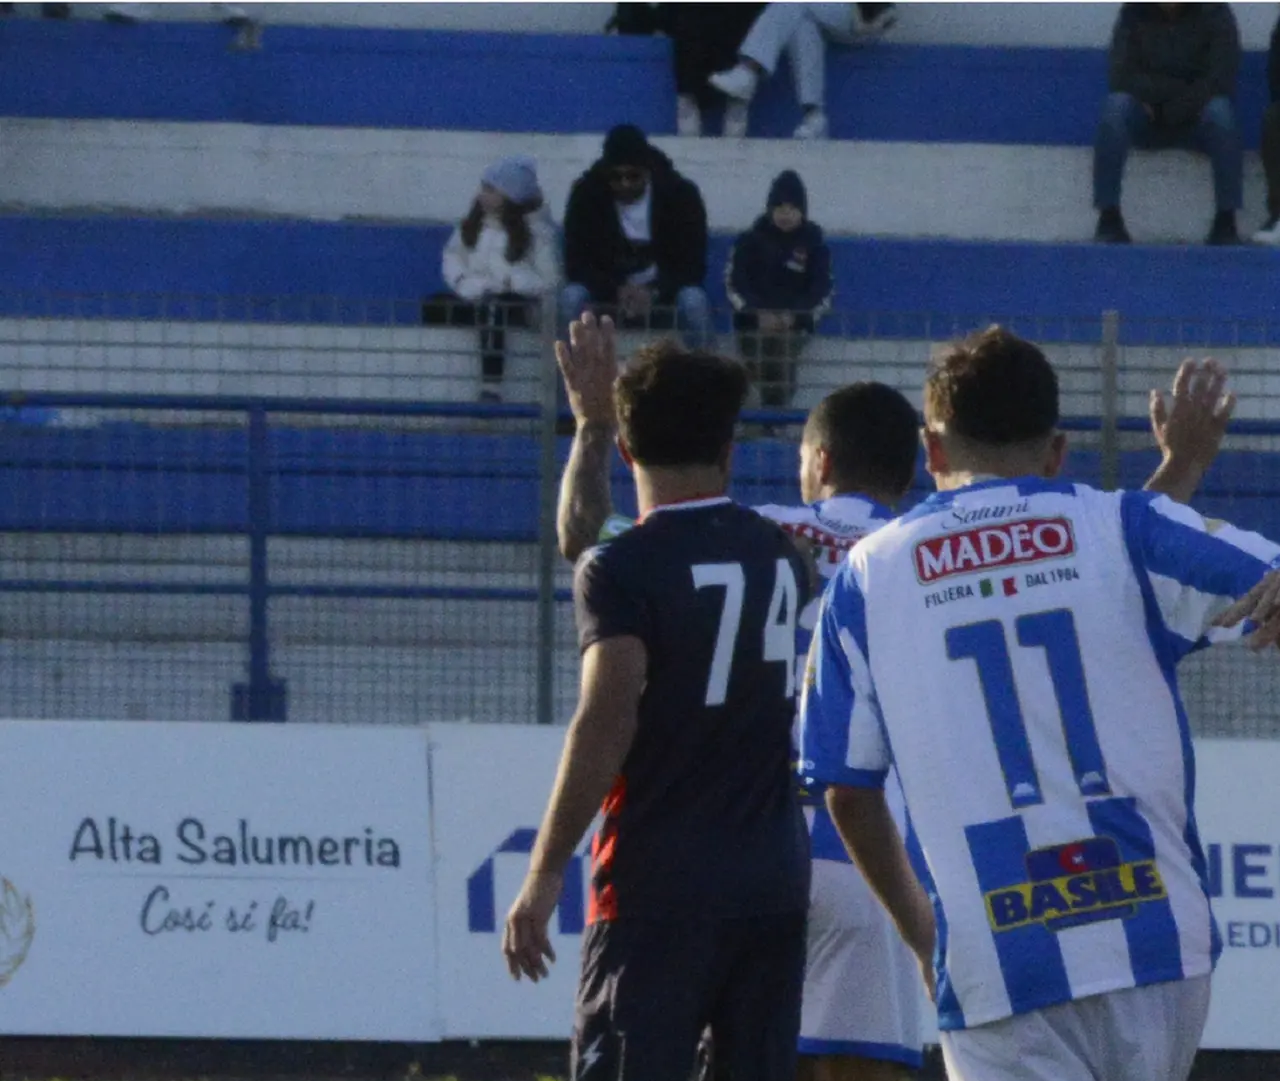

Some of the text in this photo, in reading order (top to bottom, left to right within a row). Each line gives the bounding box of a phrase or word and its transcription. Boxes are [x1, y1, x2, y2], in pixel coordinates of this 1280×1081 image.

[918, 523, 1069, 579] MADEO
[924, 584, 974, 609] FILIERA
[1025, 573, 1048, 588] DAL
[690, 557, 799, 708] 74
[944, 607, 1110, 810] 11
[69, 817, 401, 868] Alta Salumeria
[226, 901, 259, 932] si
[266, 896, 316, 943] fa!
[990, 864, 1164, 927] BASILE
